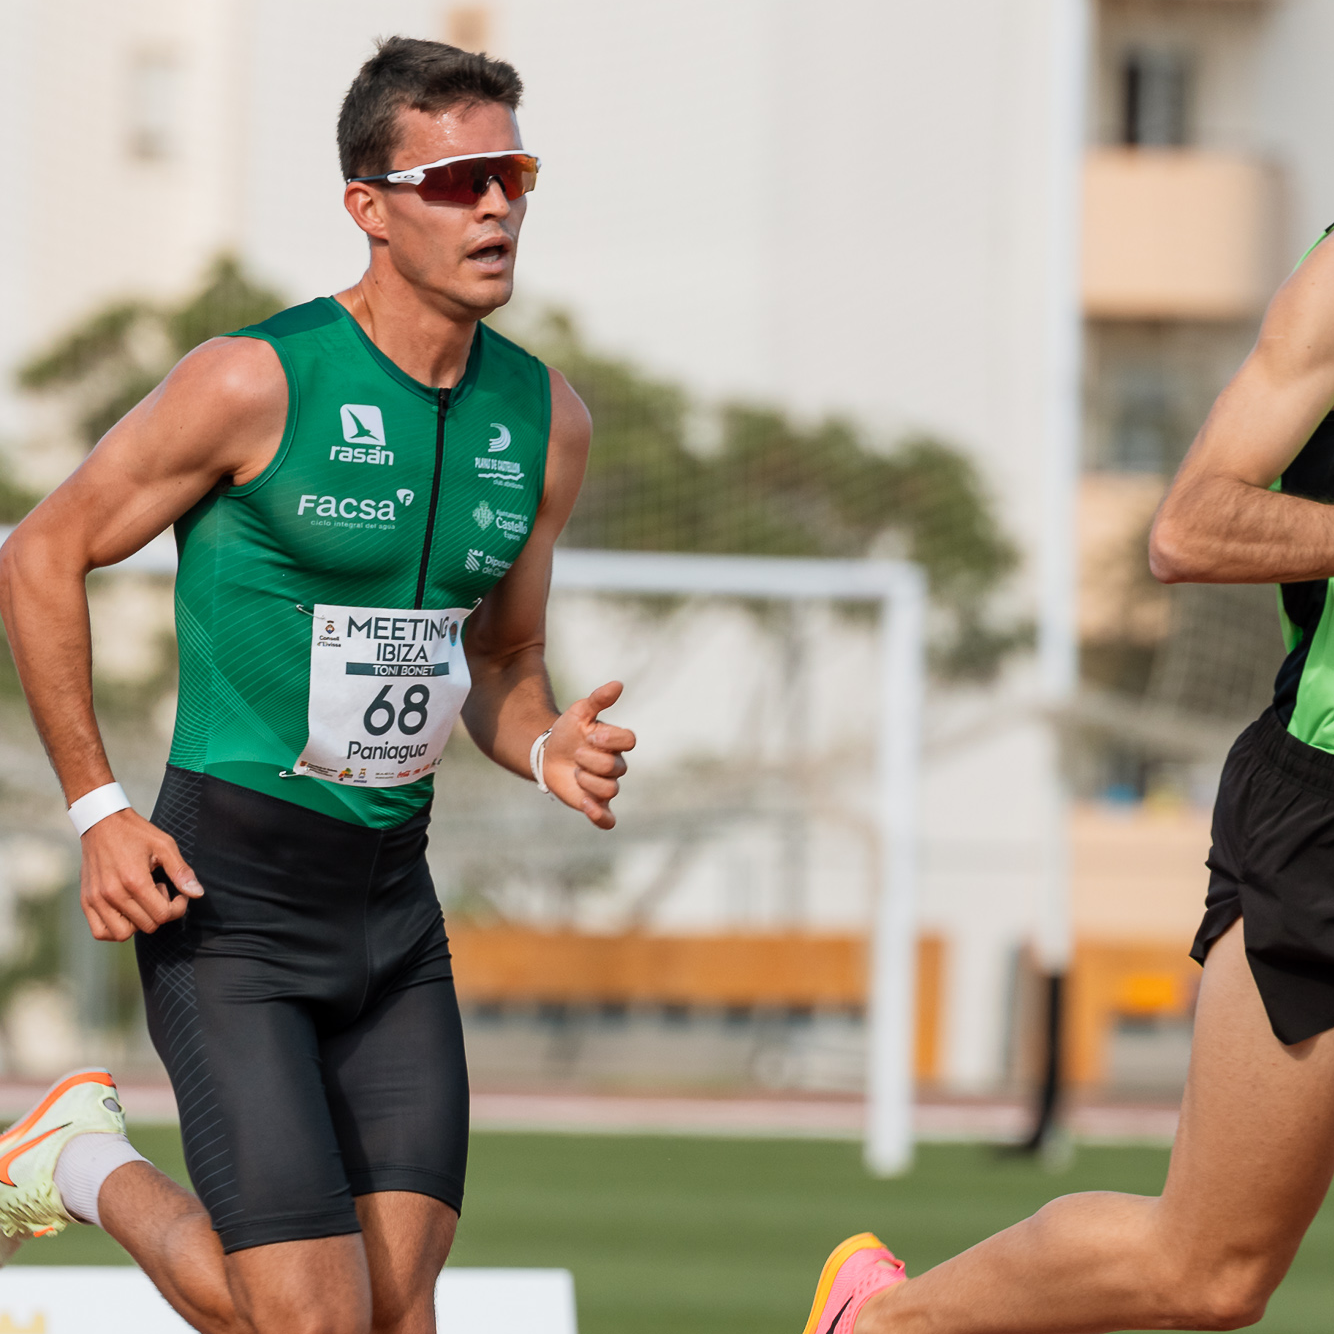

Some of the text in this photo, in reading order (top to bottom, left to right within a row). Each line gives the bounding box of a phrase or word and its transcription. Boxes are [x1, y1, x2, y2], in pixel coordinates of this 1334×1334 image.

[329, 445, 394, 466] rasán
[297, 494, 396, 521] Facsa
[333, 520, 364, 530] integral
[347, 615, 450, 641] MEETING
[376, 643, 429, 662] IBIZA
[373, 665, 435, 676] TONI BONET
[363, 683, 430, 737] 68
[347, 740, 428, 764] Paniagua
